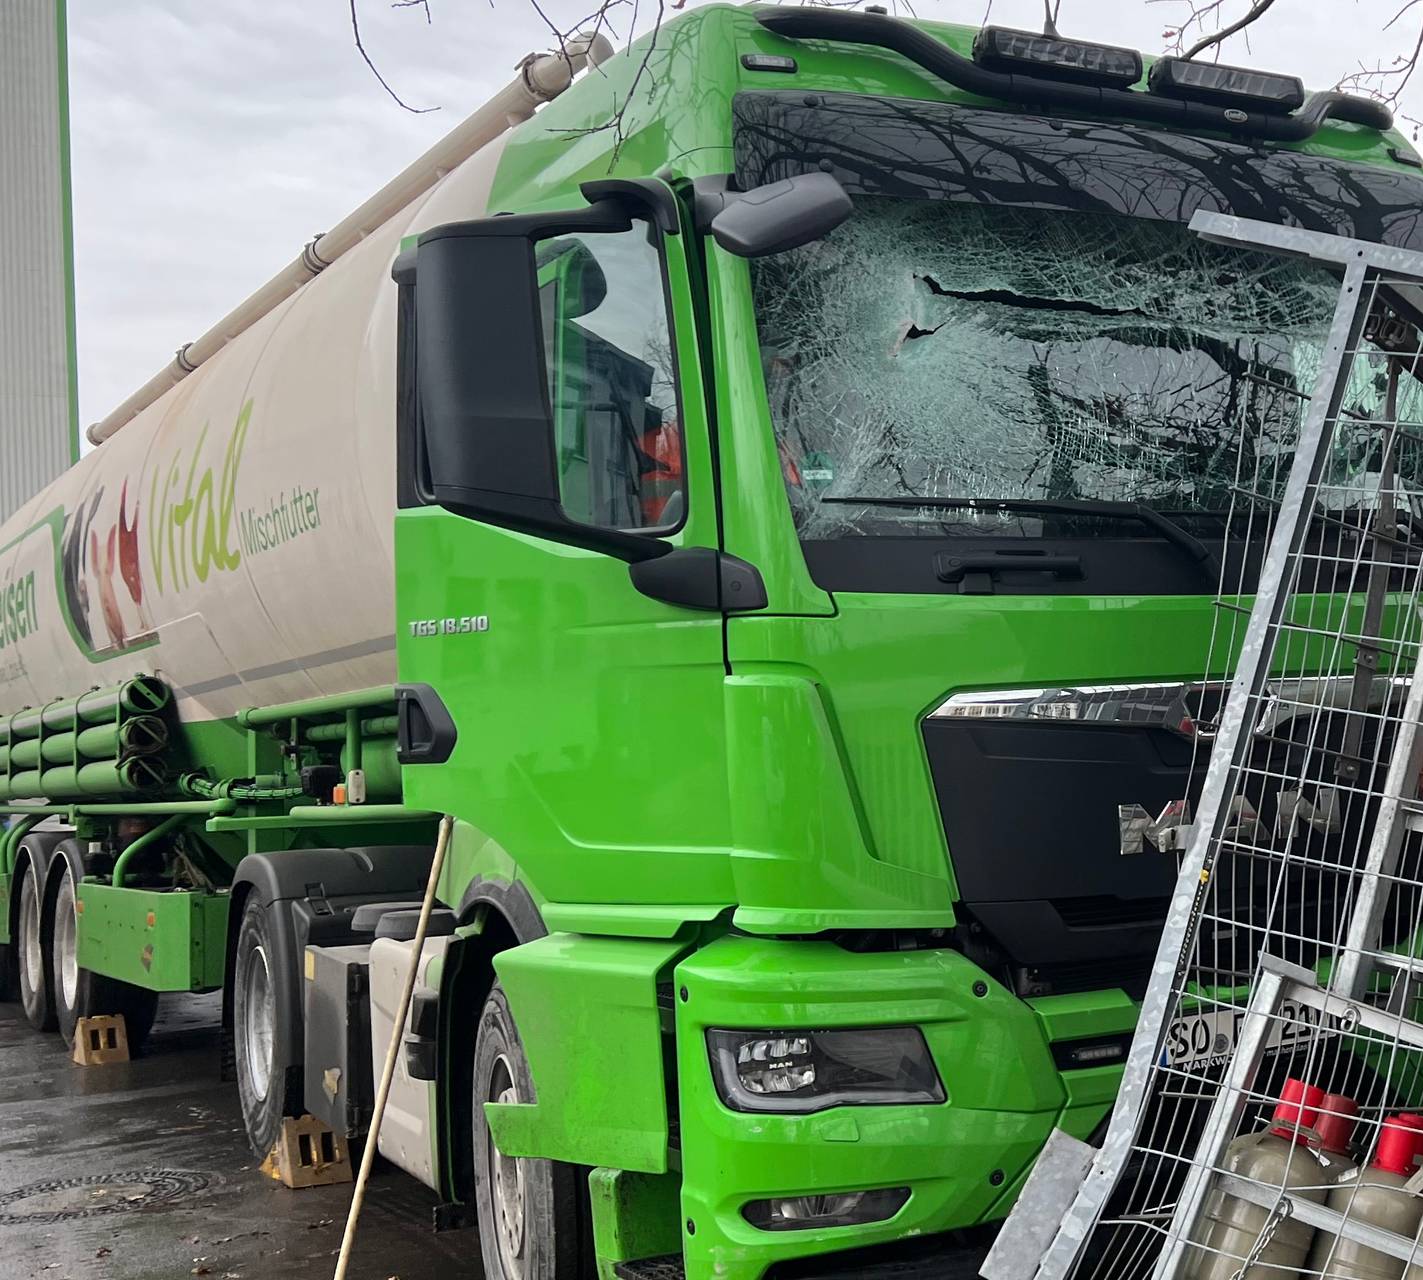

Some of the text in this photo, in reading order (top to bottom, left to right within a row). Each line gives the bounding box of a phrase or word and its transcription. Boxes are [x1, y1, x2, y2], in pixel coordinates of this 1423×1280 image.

[150, 398, 253, 594] Vital
[240, 485, 320, 557] Mischfutter
[0, 566, 39, 650] isen
[409, 615, 489, 637] TGS 18.510
[1118, 788, 1341, 855] MAN
[769, 1061, 793, 1070] MAN
[1169, 1018, 1211, 1059] SO
